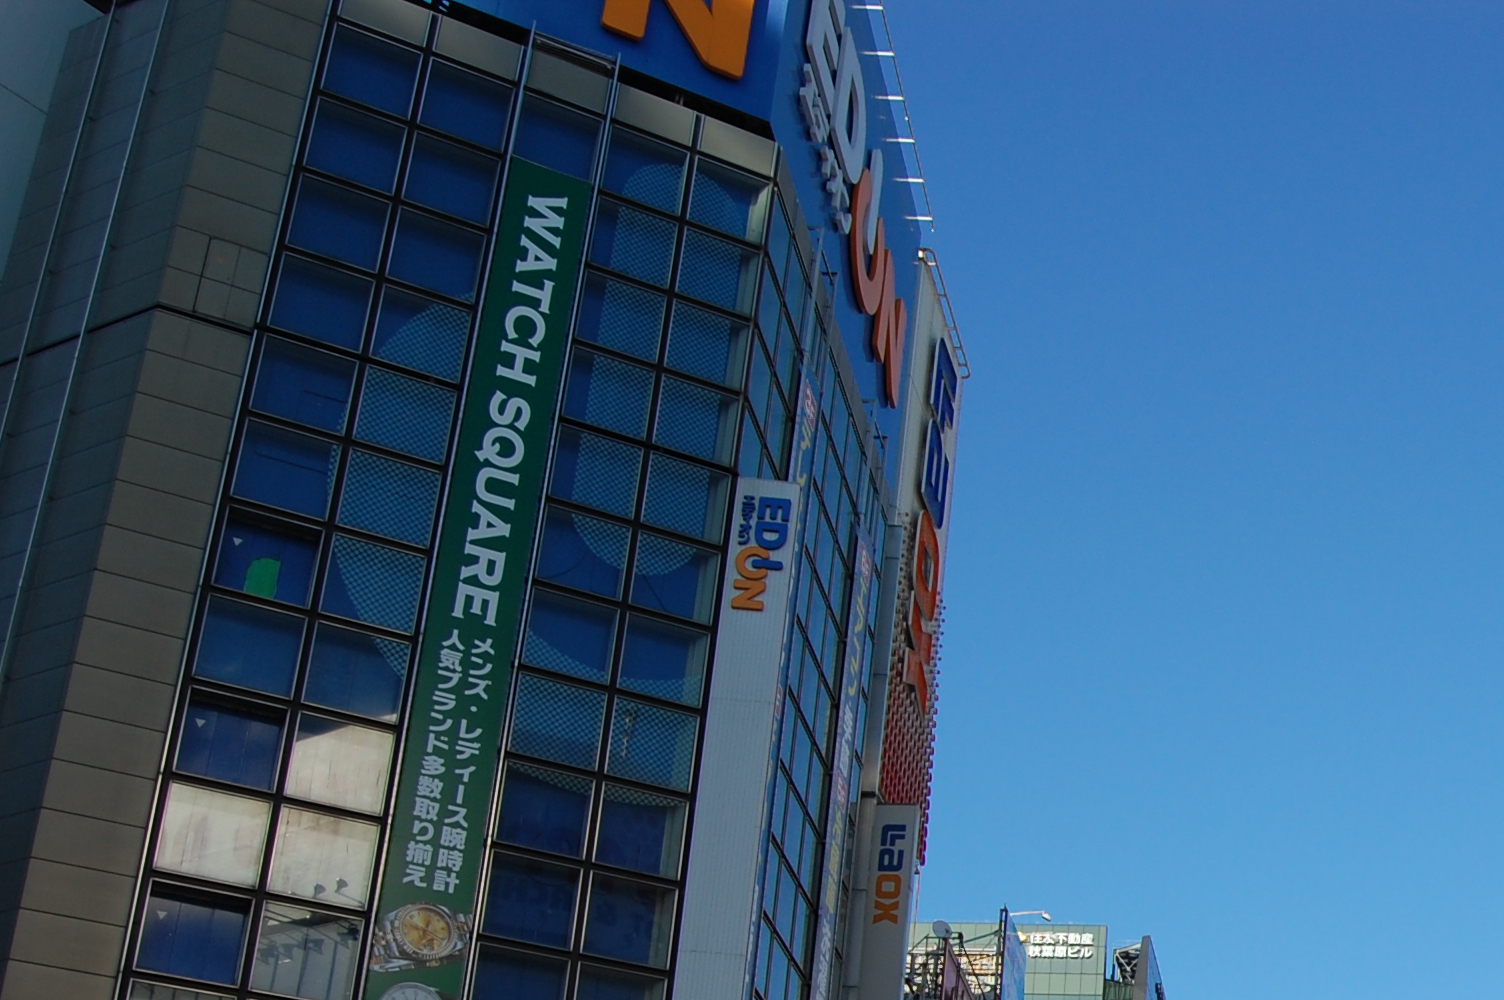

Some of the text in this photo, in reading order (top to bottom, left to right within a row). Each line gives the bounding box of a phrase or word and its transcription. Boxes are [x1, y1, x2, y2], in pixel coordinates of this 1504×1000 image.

[452, 194, 568, 629] WATCH SQUARE
[731, 497, 792, 612] EDION
[403, 630, 464, 888] 人気ブランド多数取り揃え
[433, 638, 494, 893] メンズ・レディース腕時計
